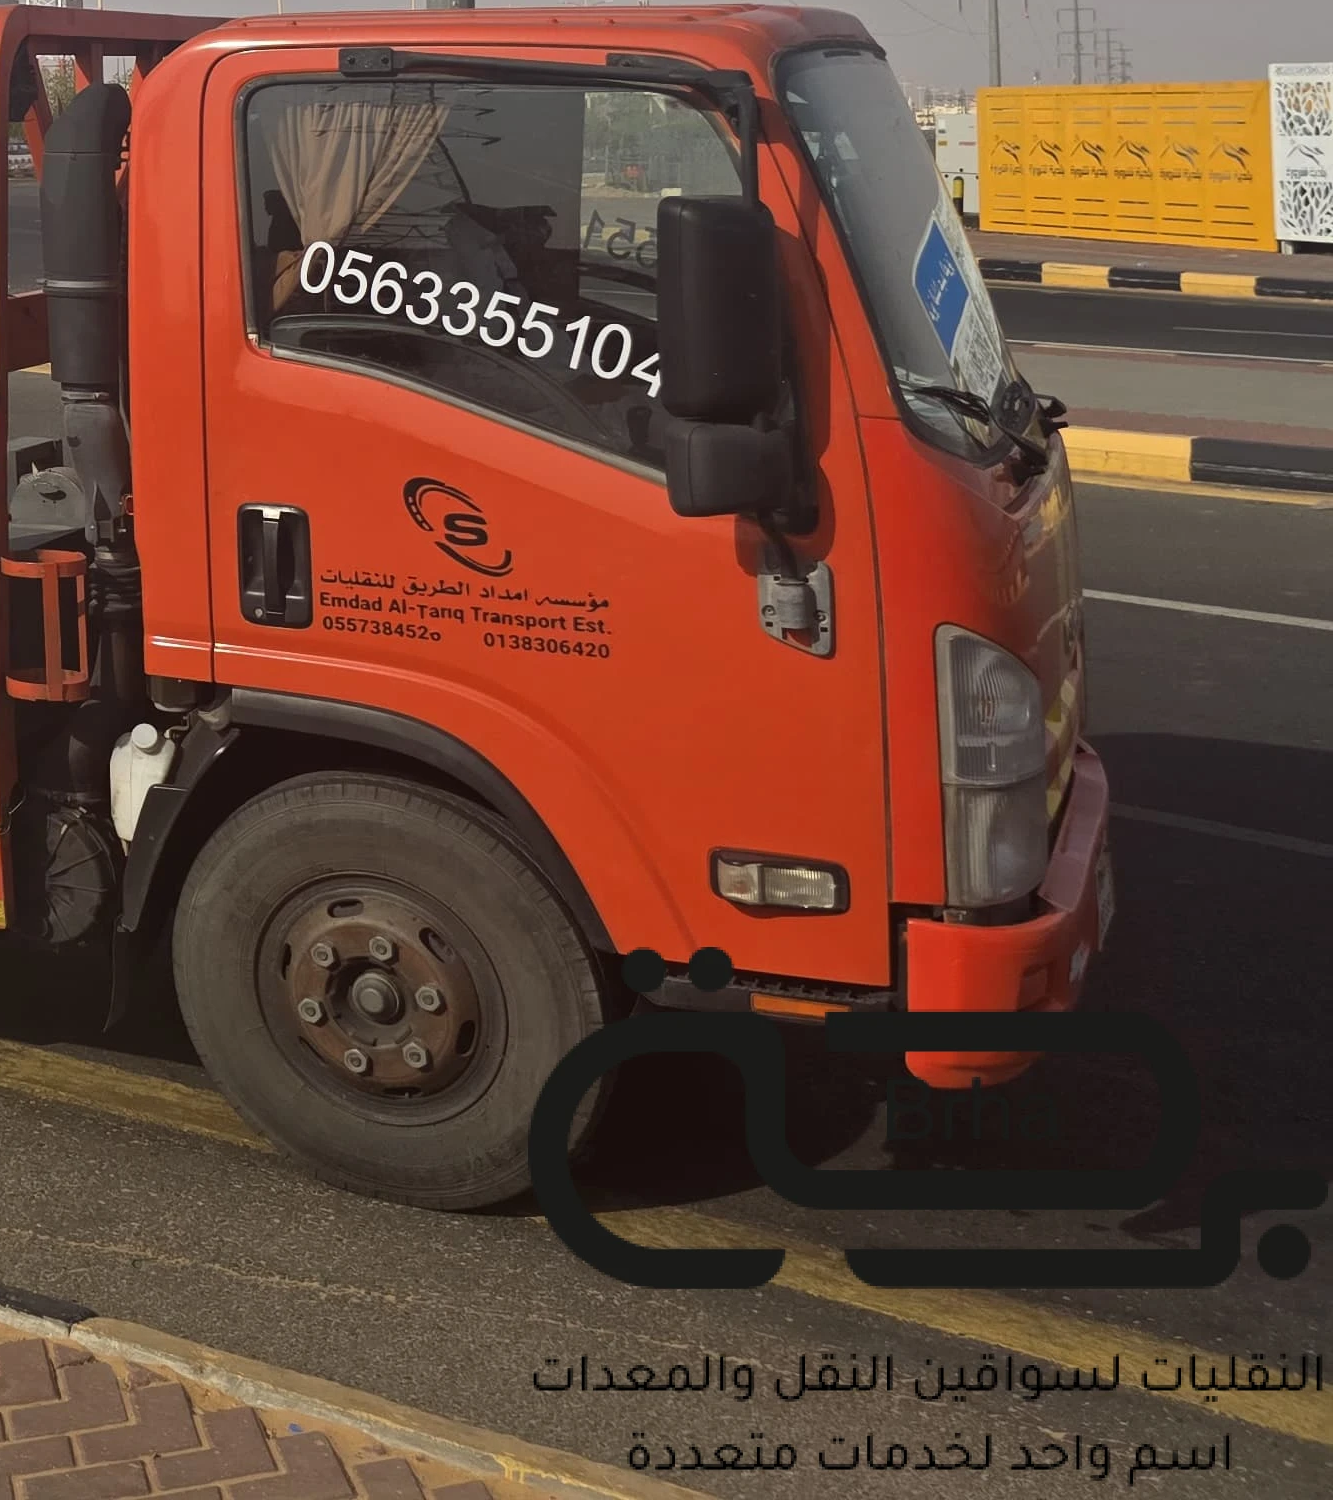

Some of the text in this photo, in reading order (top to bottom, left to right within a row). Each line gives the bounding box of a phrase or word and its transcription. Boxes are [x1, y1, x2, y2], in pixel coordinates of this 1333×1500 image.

[300, 241, 662, 398] 0563355104
[320, 569, 395, 590] للنقليات
[402, 576, 470, 597] الطريق
[479, 585, 529, 601] امداد
[319, 591, 382, 612] Emdad
[470, 606, 567, 630] Transport
[572, 616, 612, 636] Est.
[484, 632, 610, 659] 0138306420
